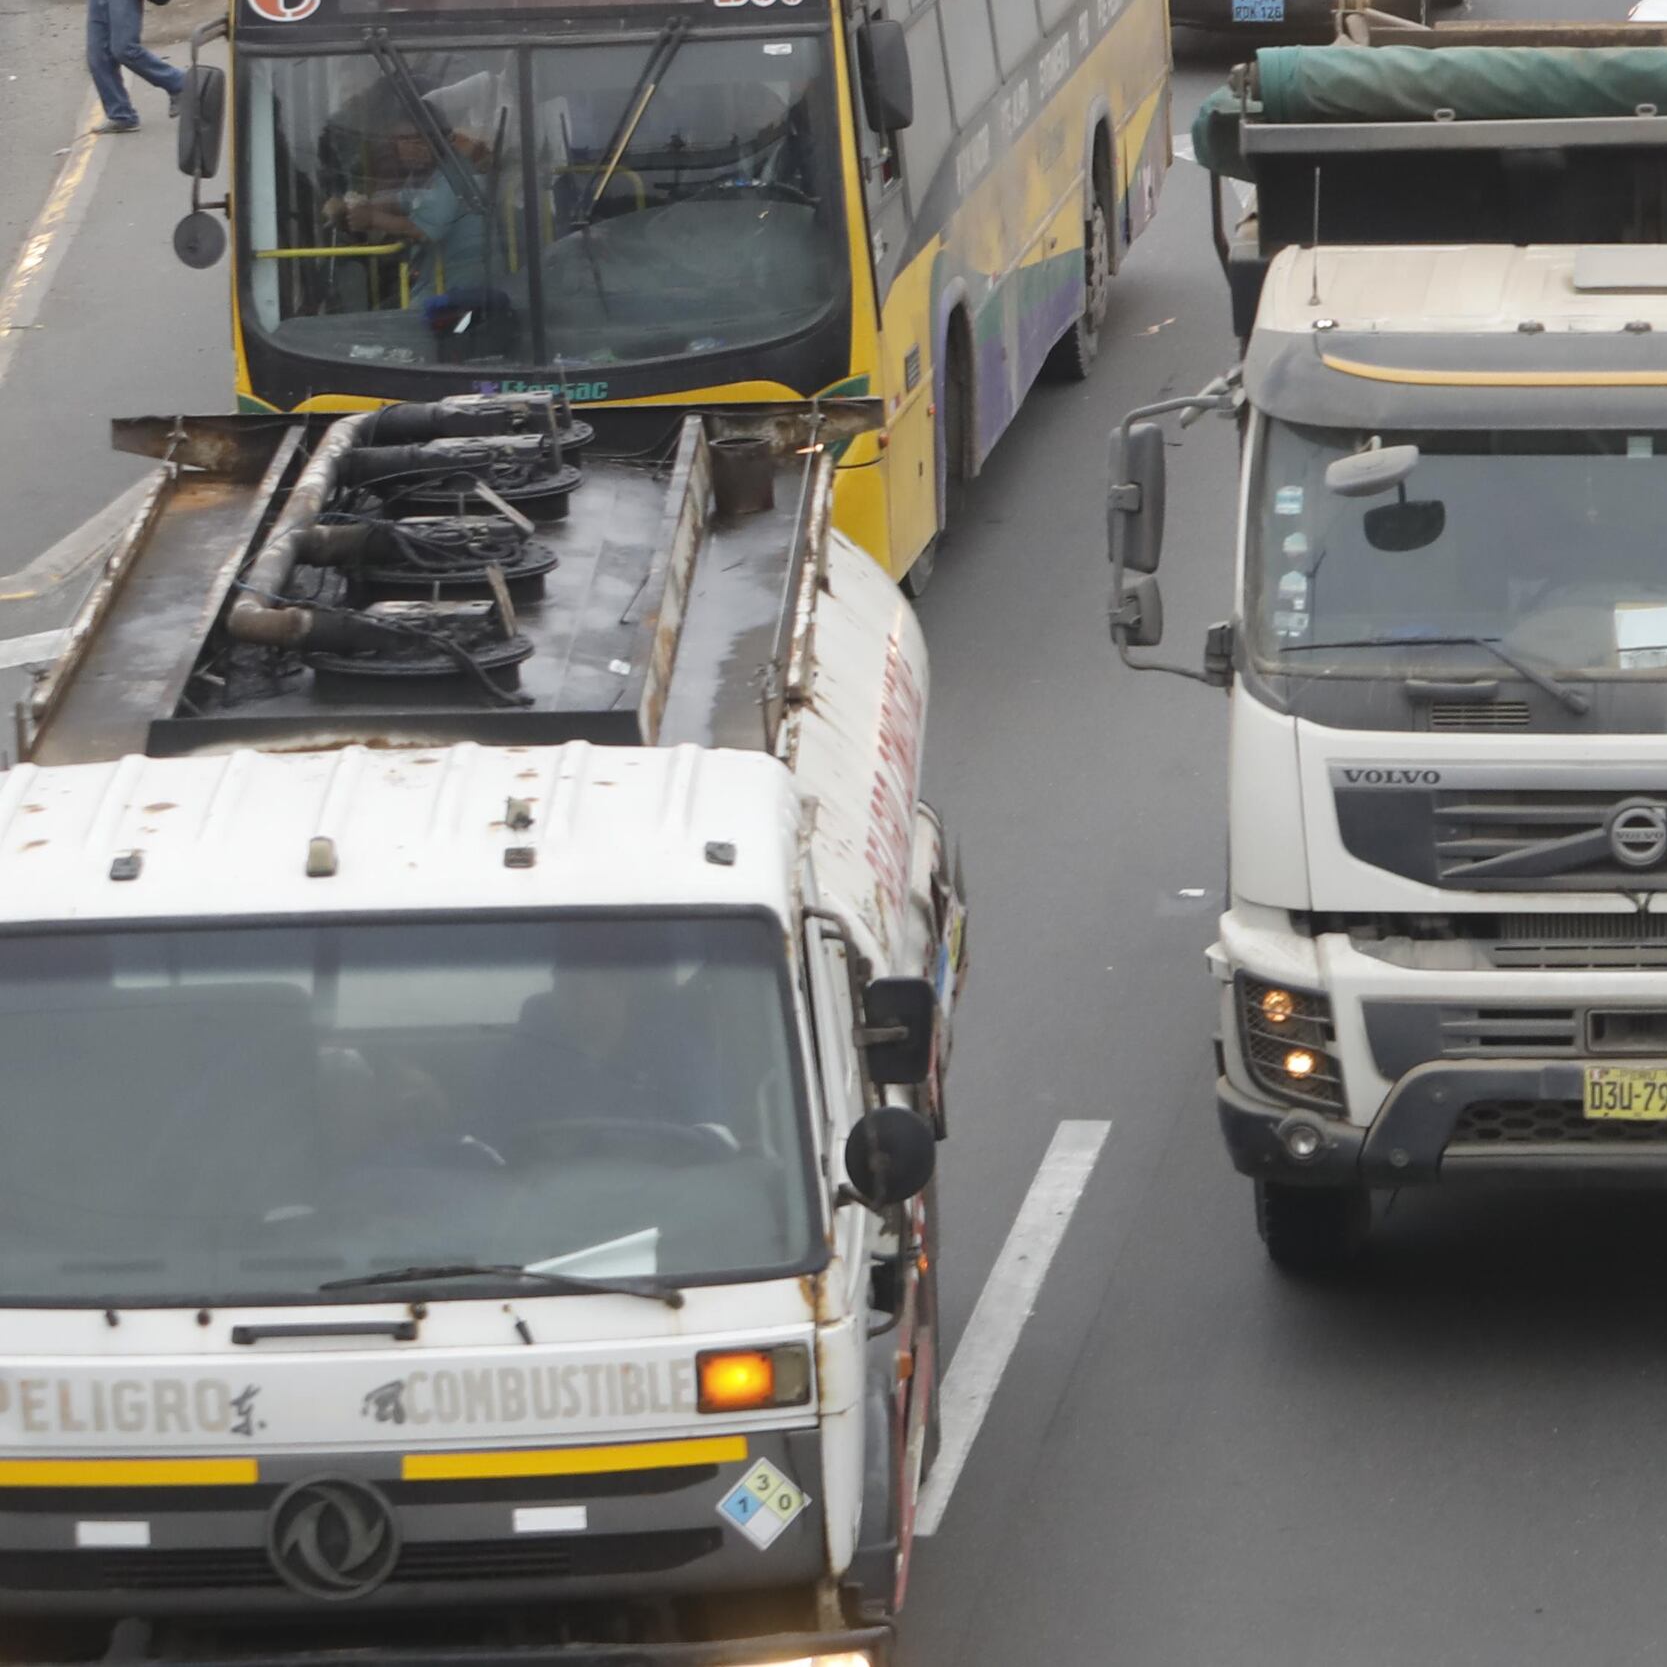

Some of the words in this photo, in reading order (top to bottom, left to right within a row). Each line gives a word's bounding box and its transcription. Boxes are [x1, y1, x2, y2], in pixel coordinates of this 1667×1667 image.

[1343, 769, 1441, 784] VOLVO
[406, 1364, 695, 1425] COMBUSTIBLE
[757, 1473, 769, 1491] 3
[739, 1496, 748, 1513] 1
[779, 1494, 791, 1511] 0
